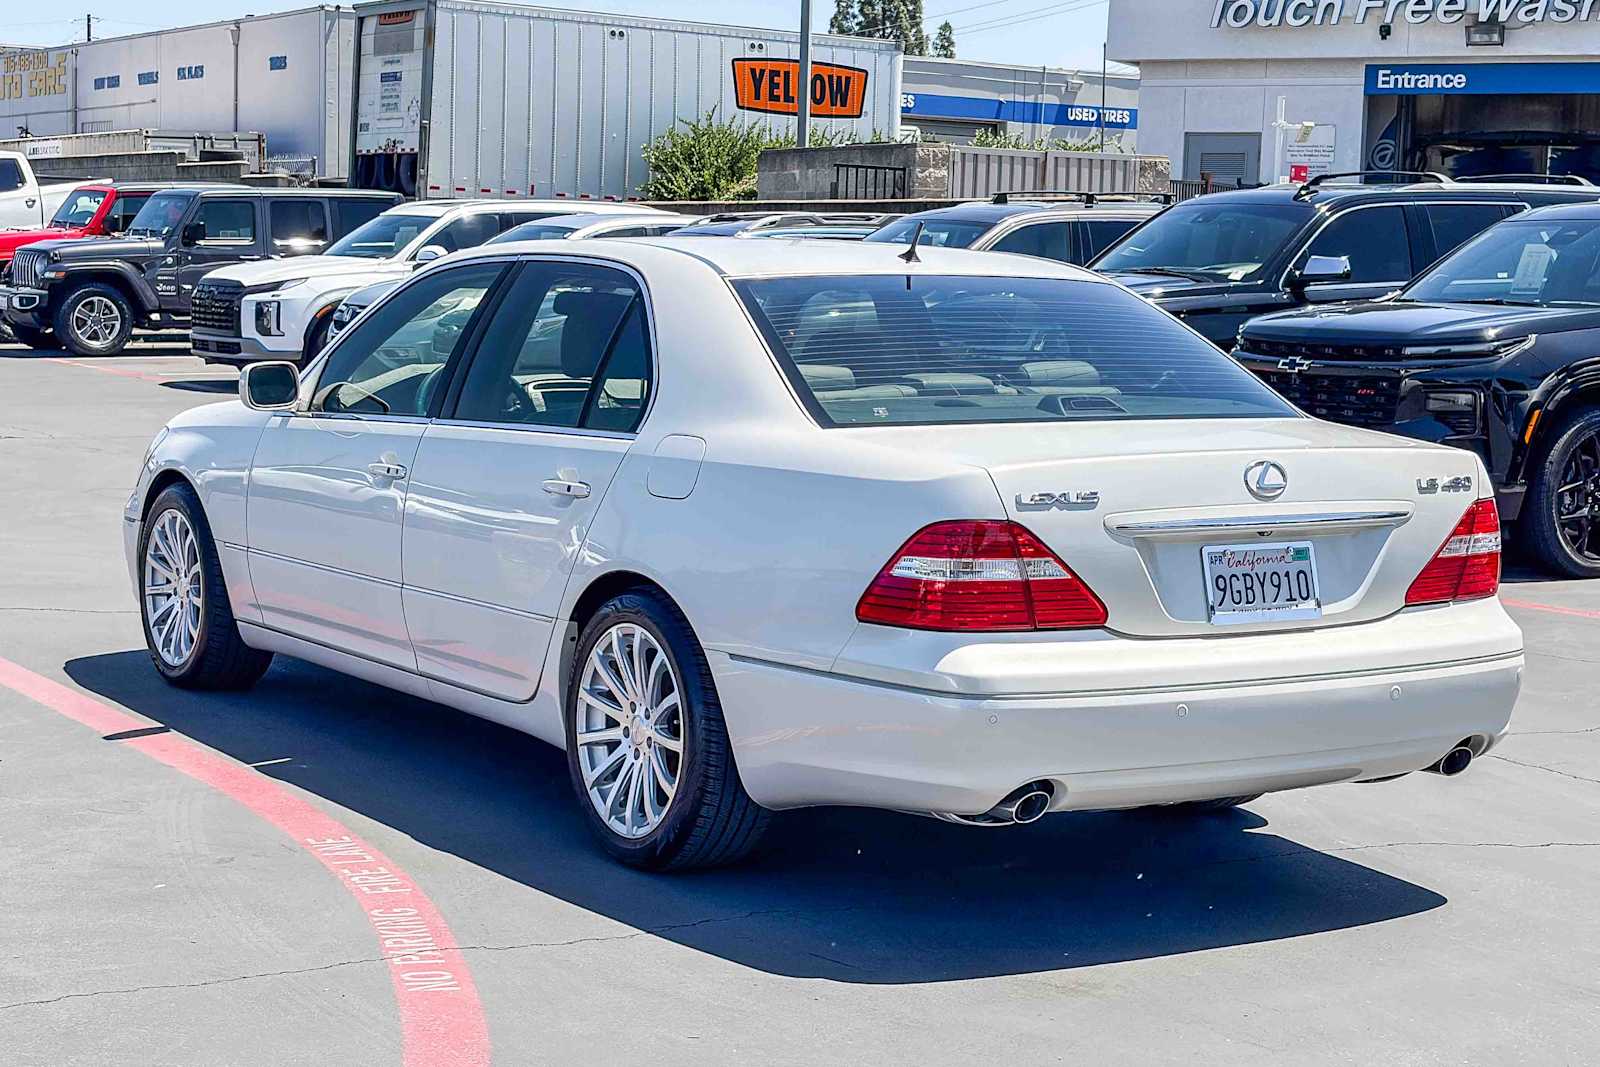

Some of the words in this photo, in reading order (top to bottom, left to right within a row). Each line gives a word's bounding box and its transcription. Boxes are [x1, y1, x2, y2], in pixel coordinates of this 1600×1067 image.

[750, 67, 852, 108] YELOW
[1377, 69, 1467, 90] Entrance
[1067, 107, 1098, 121] USED
[1416, 478, 1439, 495] LS
[1015, 491, 1100, 512] LEXUS
[1209, 554, 1224, 565] APR
[1226, 551, 1294, 571] California
[1214, 568, 1311, 608] 9GBY910
[305, 835, 377, 865] LANE
[341, 866, 413, 895] FIRE
[371, 907, 446, 965] PARKING
[401, 970, 462, 992] NO
